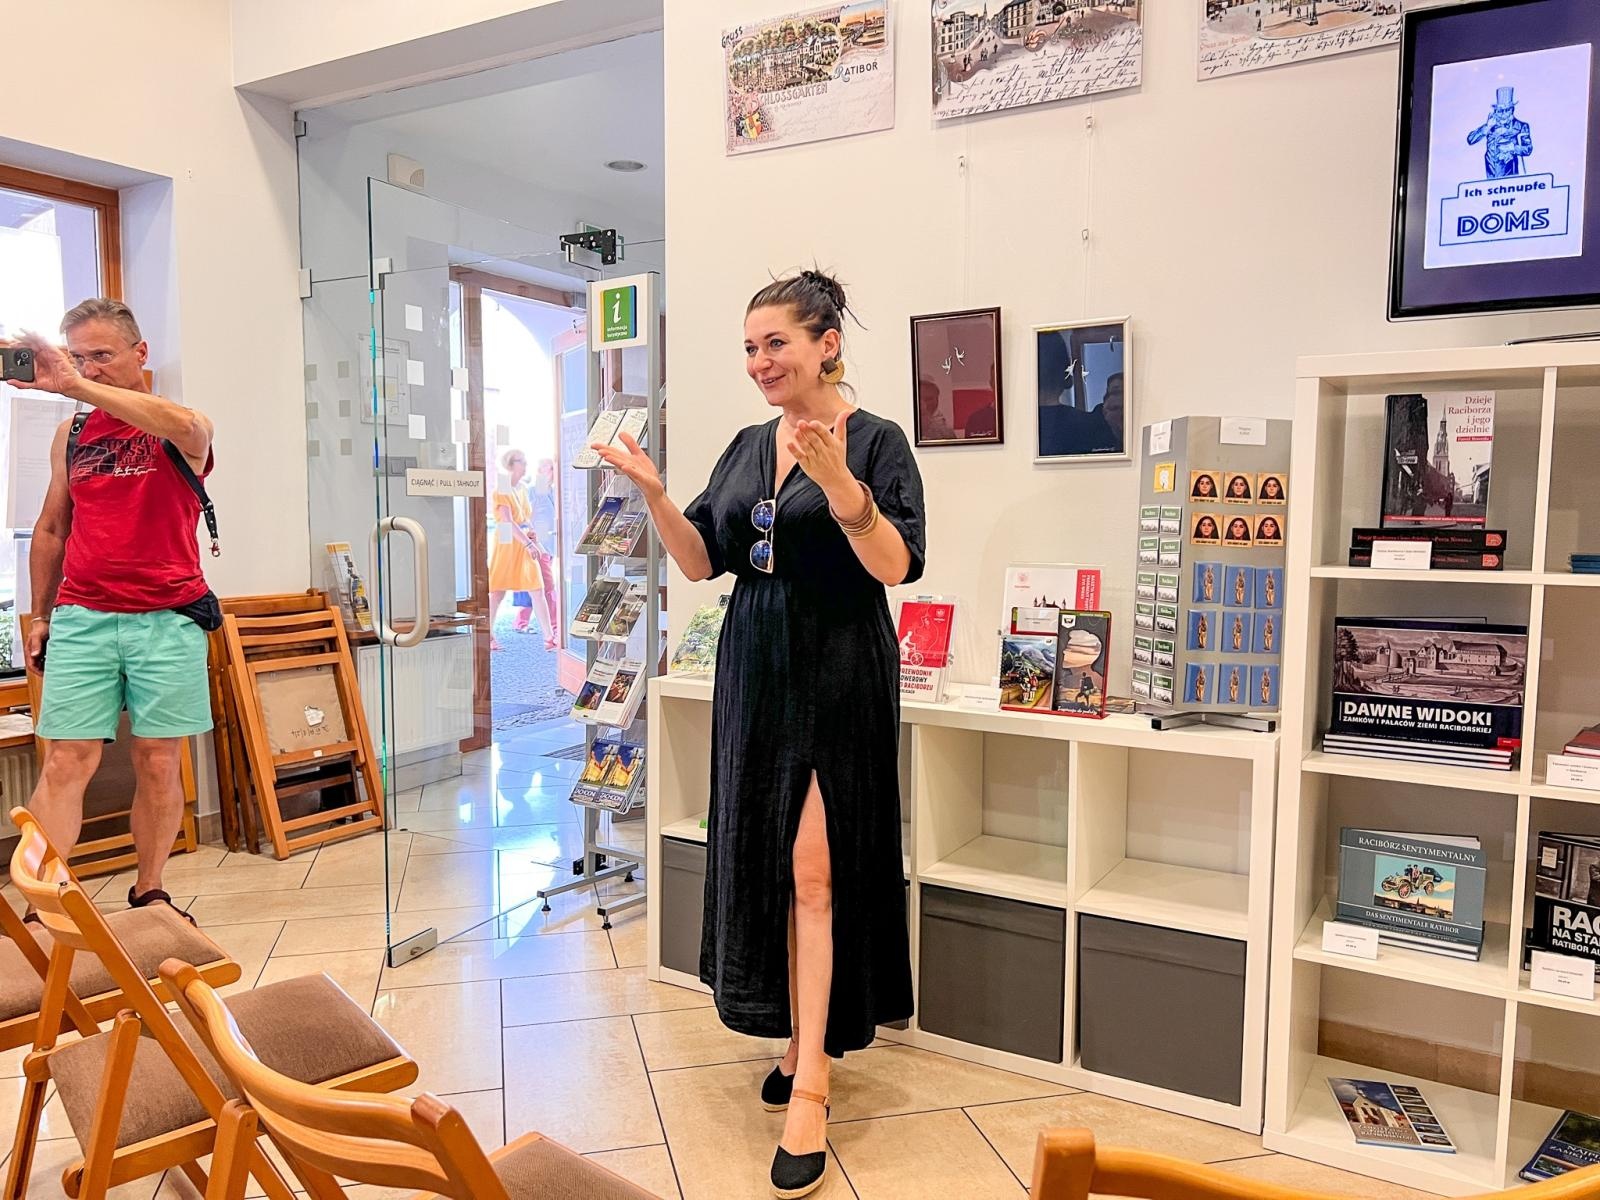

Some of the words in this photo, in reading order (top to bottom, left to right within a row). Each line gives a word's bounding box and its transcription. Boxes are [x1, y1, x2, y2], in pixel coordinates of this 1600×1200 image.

[833, 61, 878, 82] RATIBOR
[1464, 186, 1482, 198] Ich
[1487, 181, 1546, 195] schnupfe
[1491, 197, 1516, 207] nur
[1457, 208, 1550, 237] DOMS
[1465, 396, 1492, 405] Dzieje
[1448, 406, 1491, 415] Raciborza
[1467, 415, 1471, 424] i
[1472, 415, 1491, 425] jego
[1456, 425, 1490, 434] dzielnic
[440, 479, 452, 487] PULL
[900, 668, 932, 676] RZEWODNIK
[900, 675, 927, 683] OWEROWY
[1344, 701, 1412, 719] DAWNE
[1416, 706, 1492, 726] WIDOKI
[1343, 716, 1374, 724] ZAMKÓW
[1440, 723, 1492, 734] RACIBORSKIEJ
[1358, 837, 1401, 850] RACIBÓRZ
[1401, 843, 1477, 862] SENTYMENTALNY
[1366, 910, 1379, 918] DAS
[1379, 913, 1428, 929] SENTIMENTALE
[1429, 922, 1460, 935] RATIBOR
[1553, 927, 1571, 940] NA
[1574, 932, 1600, 947] STA
[1552, 938, 1589, 953] RATIBOR
